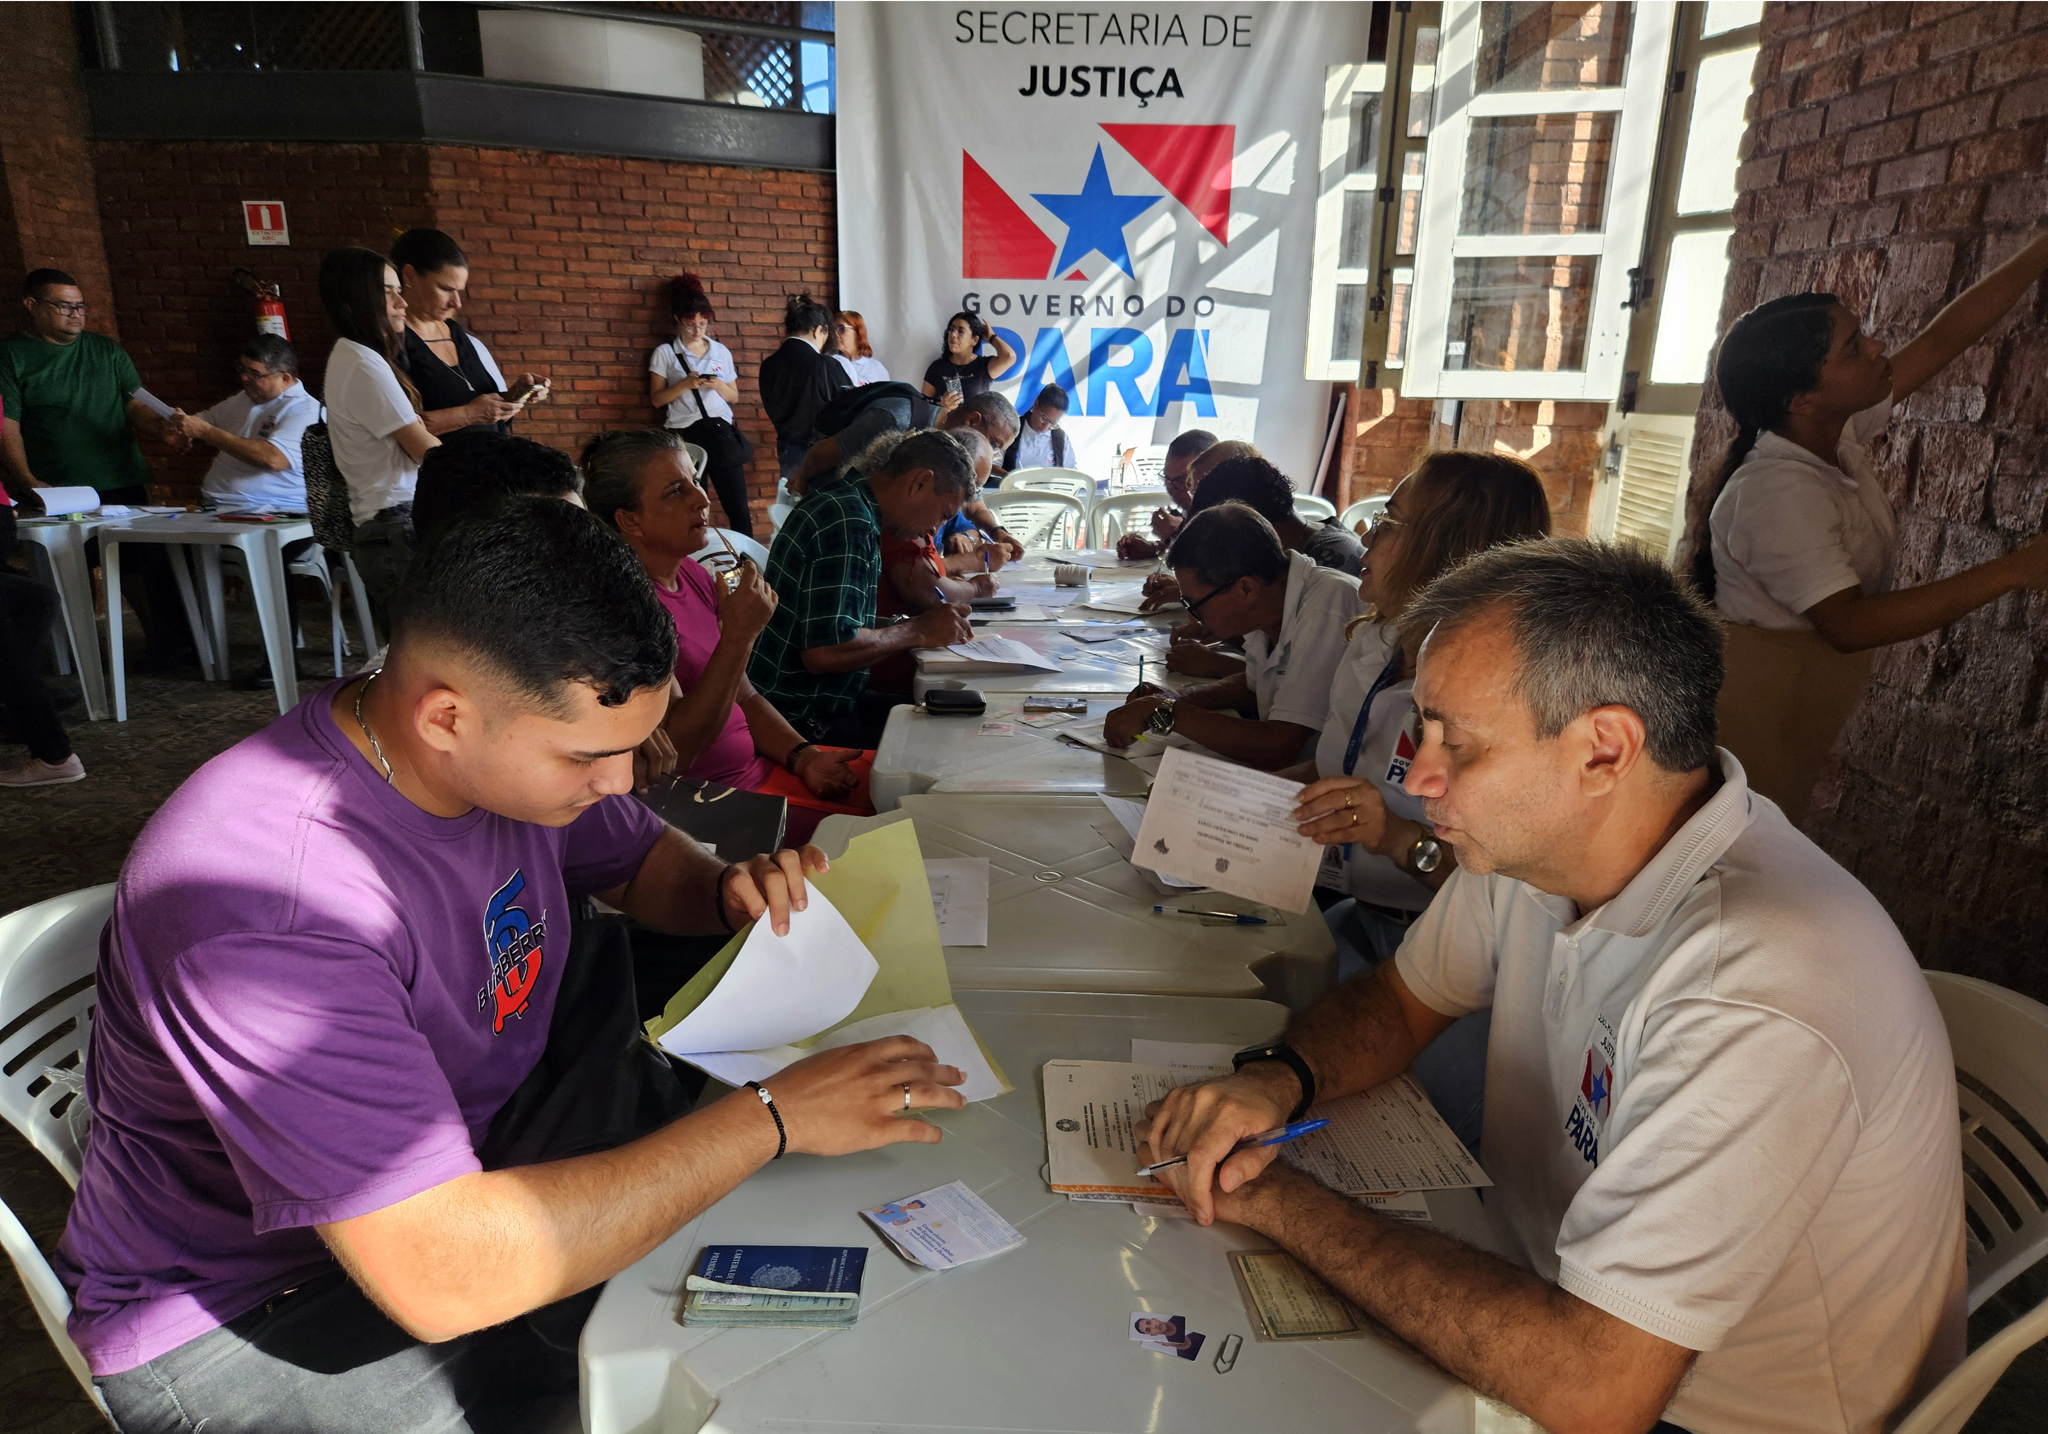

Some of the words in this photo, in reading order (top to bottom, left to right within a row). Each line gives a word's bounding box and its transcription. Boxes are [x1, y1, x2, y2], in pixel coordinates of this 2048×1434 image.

[955, 9, 1189, 46] SECRETARIA
[1202, 14, 1253, 47] DE
[1018, 64, 1185, 108] JUSTIÇA
[961, 292, 1145, 318] GOVERNO
[1166, 295, 1216, 318] DO
[729, 1249, 743, 1272] CARTEIRA
